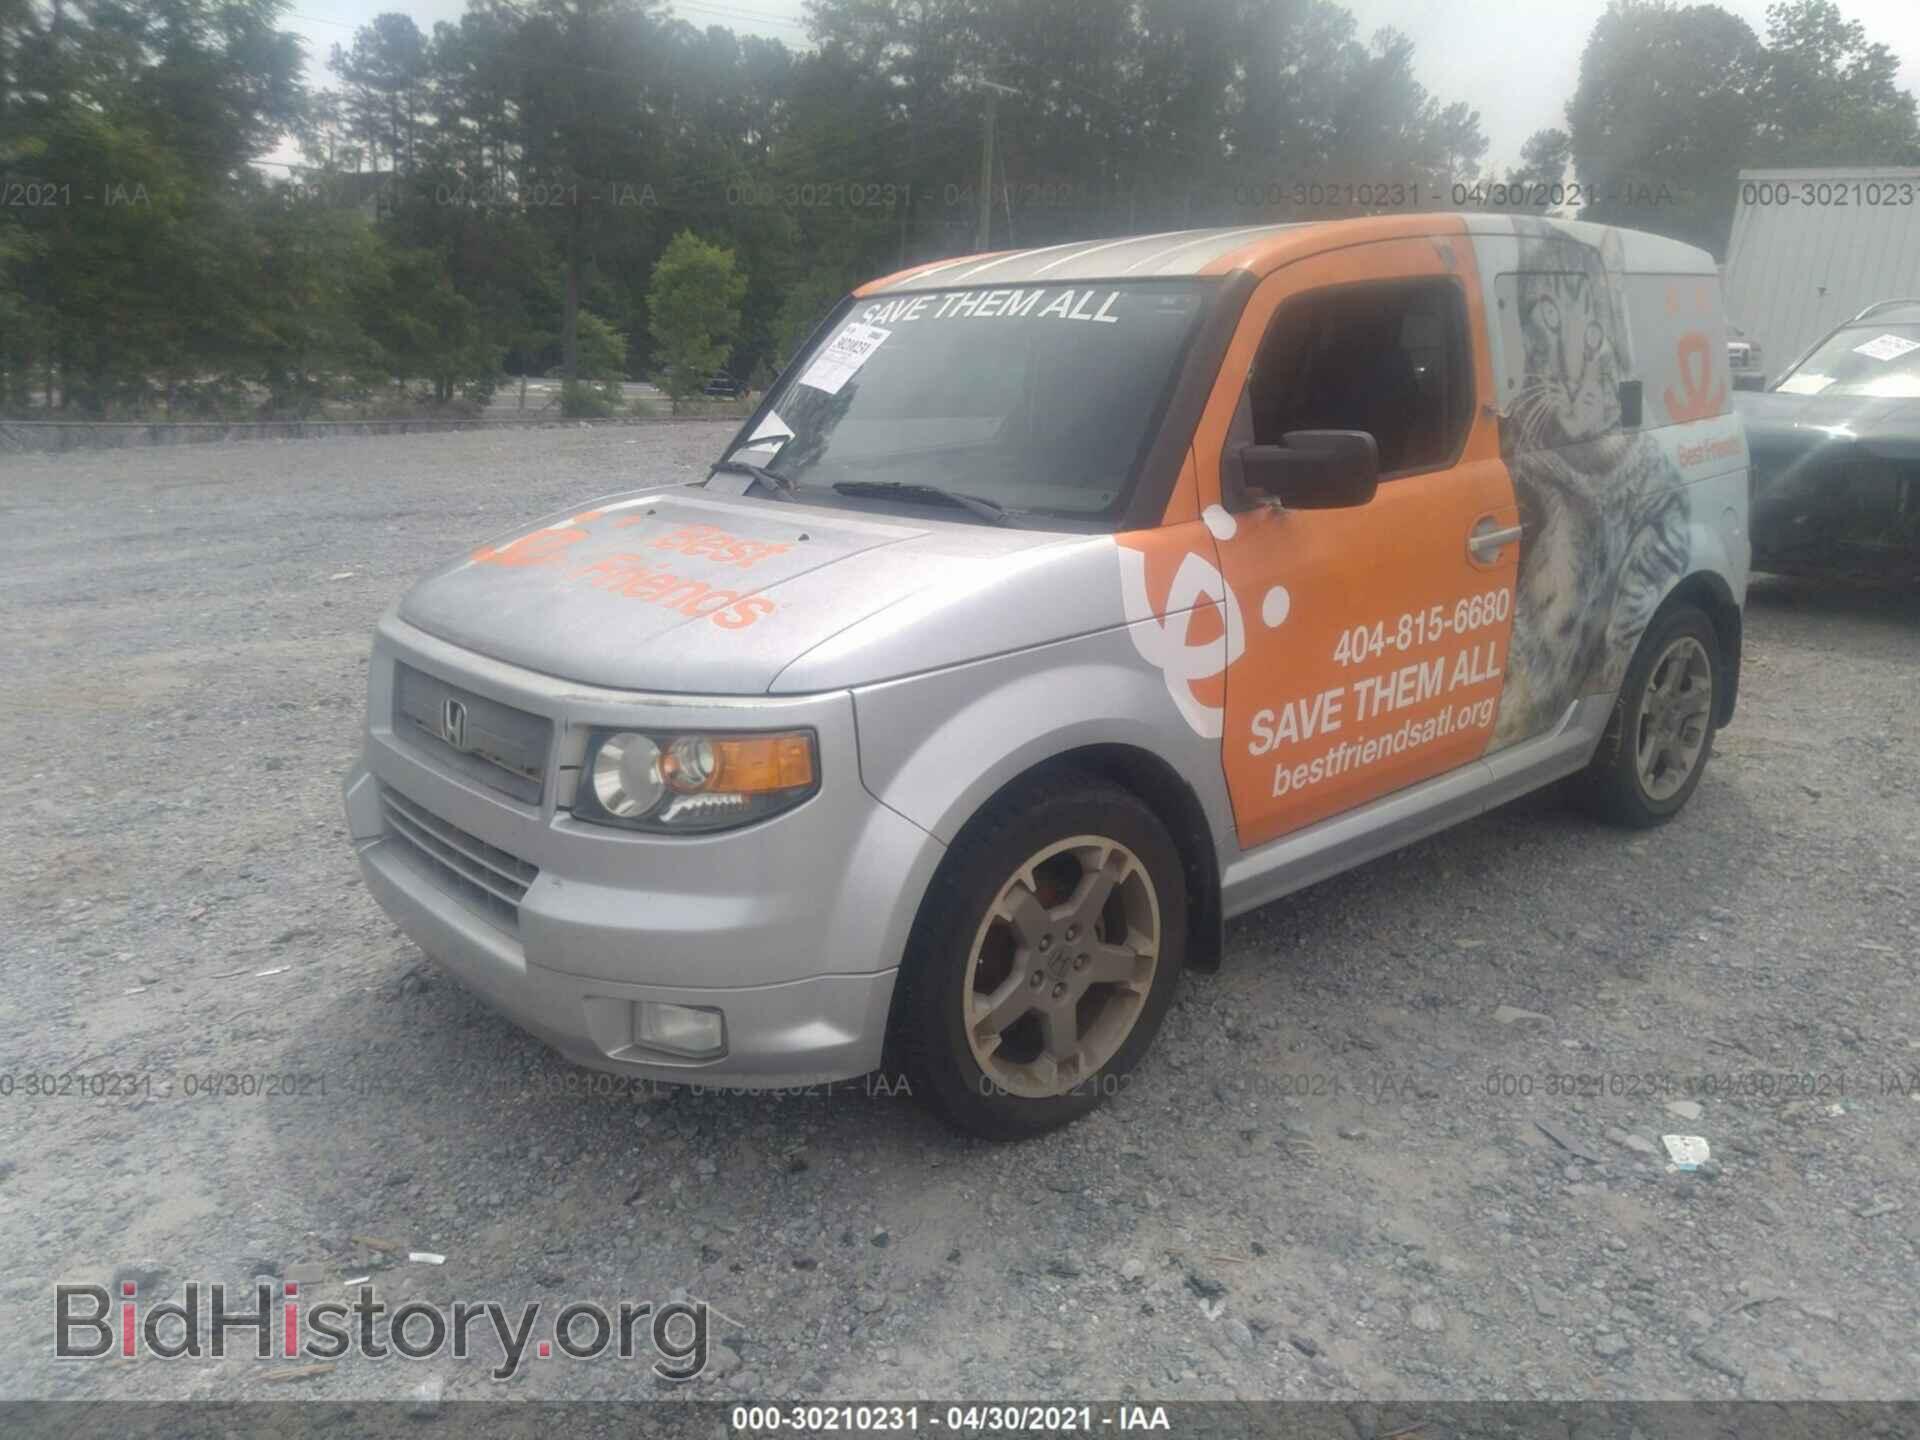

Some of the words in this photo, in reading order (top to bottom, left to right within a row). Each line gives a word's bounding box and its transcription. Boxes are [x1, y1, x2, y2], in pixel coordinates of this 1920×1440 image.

[862, 295, 936, 325] SAVE
[934, 290, 1046, 319] THEM
[1038, 290, 1121, 323] ALL
[1333, 588, 1510, 667] 404-815-6680
[1248, 687, 1345, 756] SAVE
[1353, 656, 1444, 721] THEM
[1449, 641, 1501, 692] ALL
[1272, 697, 1495, 798] bestfriendsatl.org
